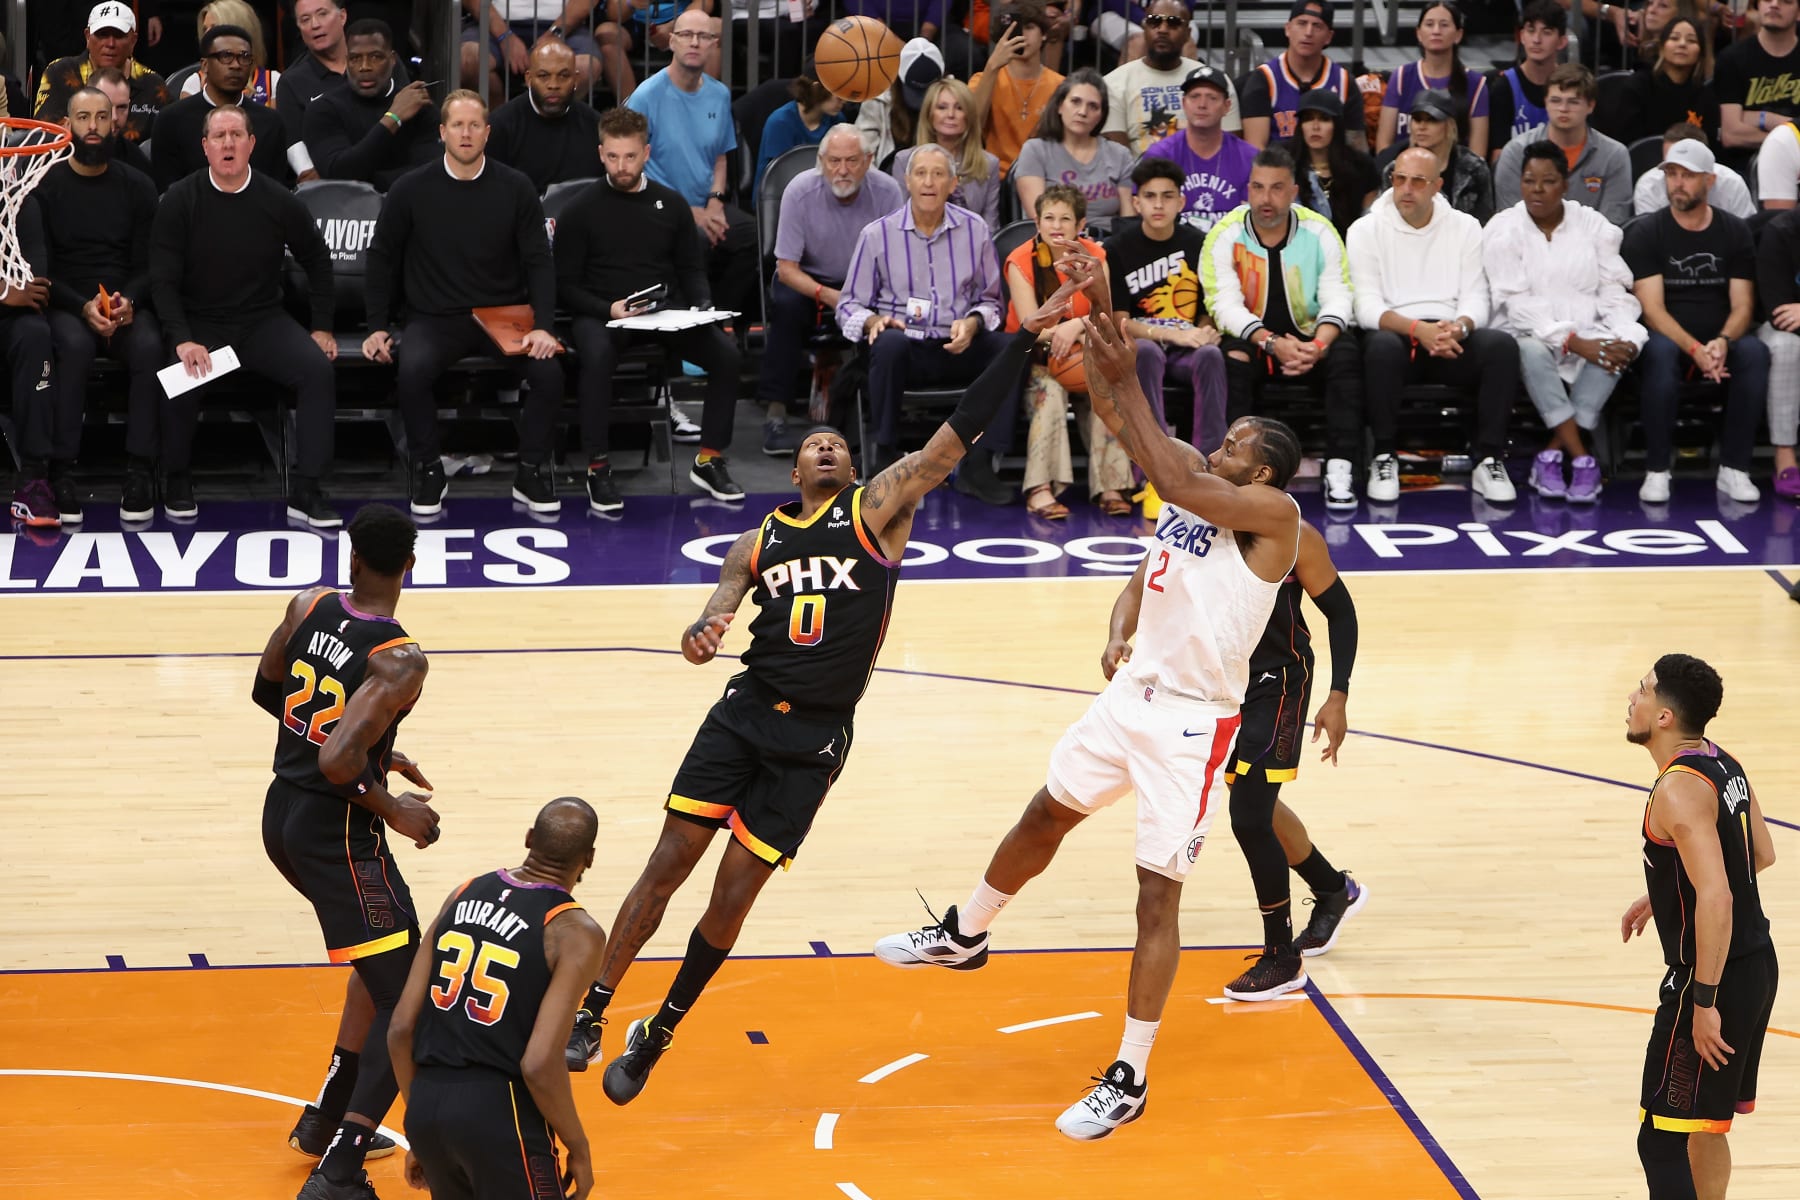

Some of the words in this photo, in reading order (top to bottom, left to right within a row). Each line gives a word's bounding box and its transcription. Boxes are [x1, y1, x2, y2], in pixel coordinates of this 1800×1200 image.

[99, 6, 120, 17] #1
[1181, 172, 1237, 200] HOENIX
[338, 251, 357, 261] Pixel
[827, 519, 850, 529] PayPal
[1352, 519, 1750, 558] Pixel
[761, 556, 862, 599] PHX
[1147, 549, 1170, 593] 2
[788, 594, 827, 647] 0
[306, 631, 354, 671] AYTON
[283, 658, 346, 747] 22
[454, 899, 530, 942] DURANT
[430, 929, 520, 1027] 35
